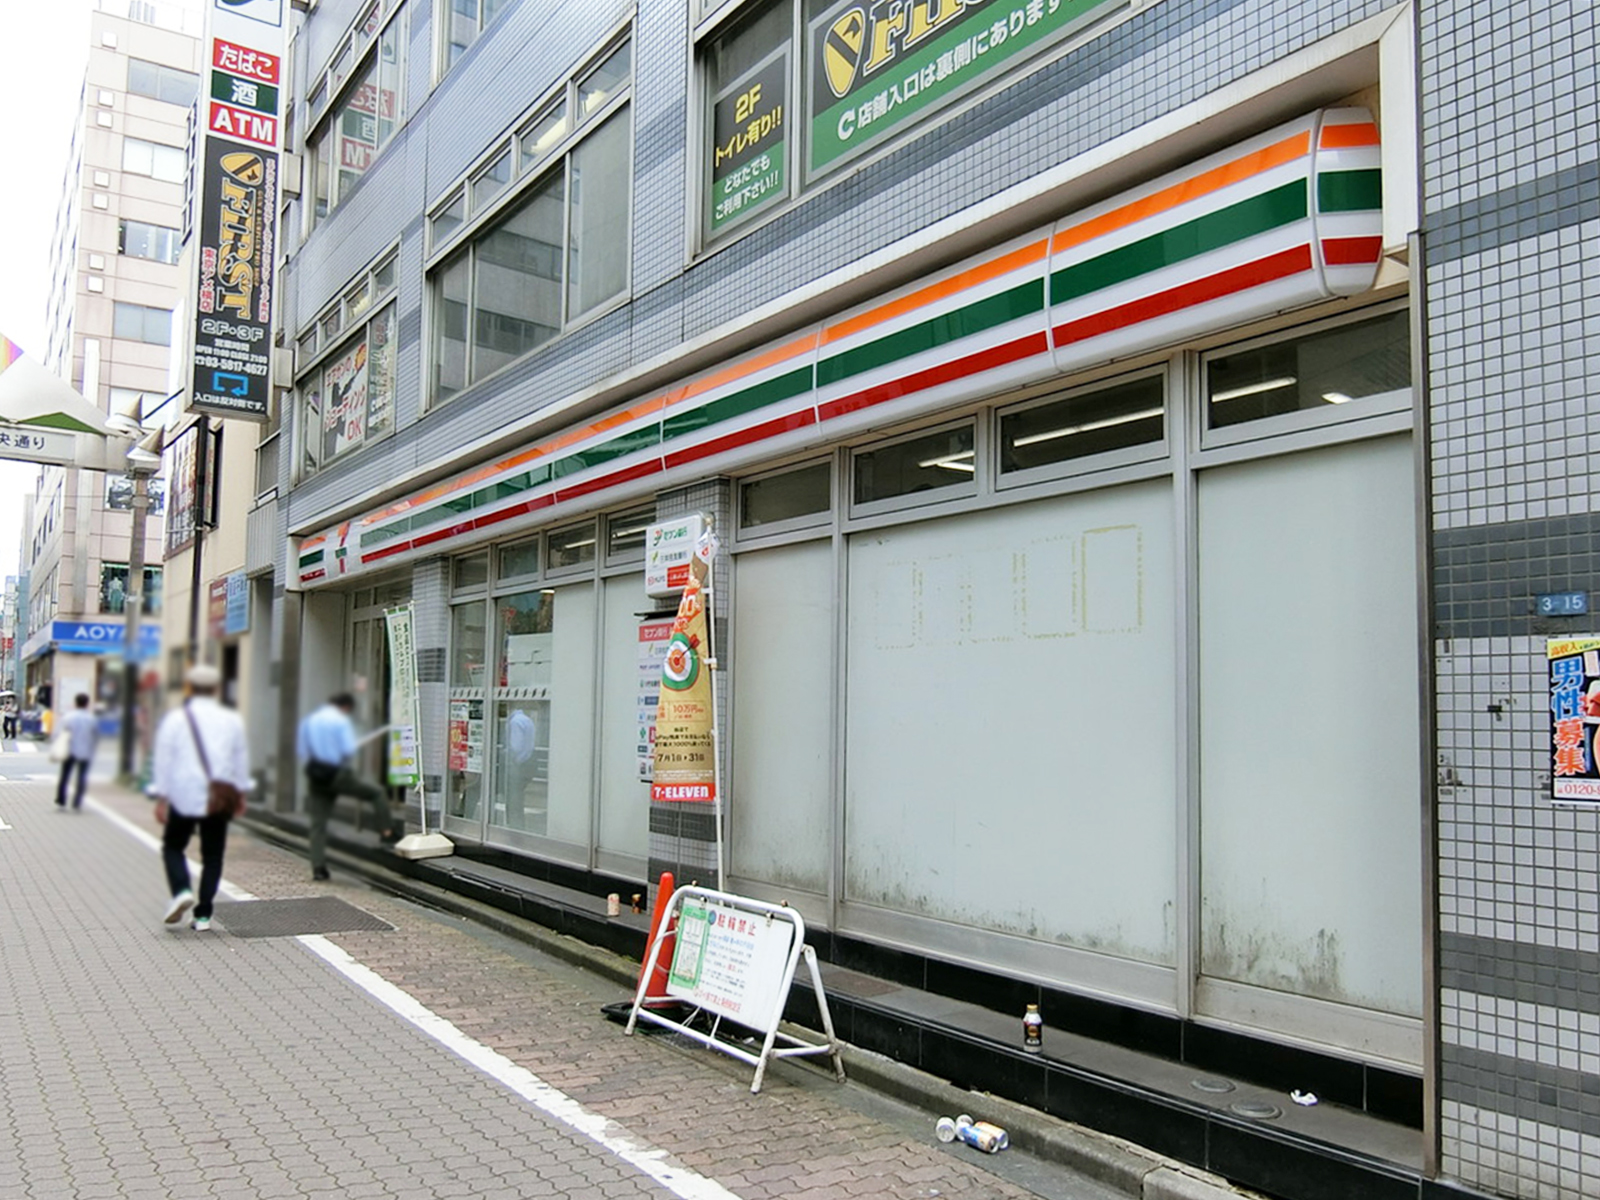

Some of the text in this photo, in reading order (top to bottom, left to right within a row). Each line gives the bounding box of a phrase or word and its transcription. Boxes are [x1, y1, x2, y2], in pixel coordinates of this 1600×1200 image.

[219, 44, 273, 80] たばこ
[231, 79, 259, 107] 酒
[735, 83, 761, 124] 2F
[213, 108, 273, 143] ATM
[724, 154, 770, 194] どなたでも
[217, 177, 257, 319] FIRST
[347, 415, 362, 441] OK
[1551, 656, 1587, 777] 男性募集
